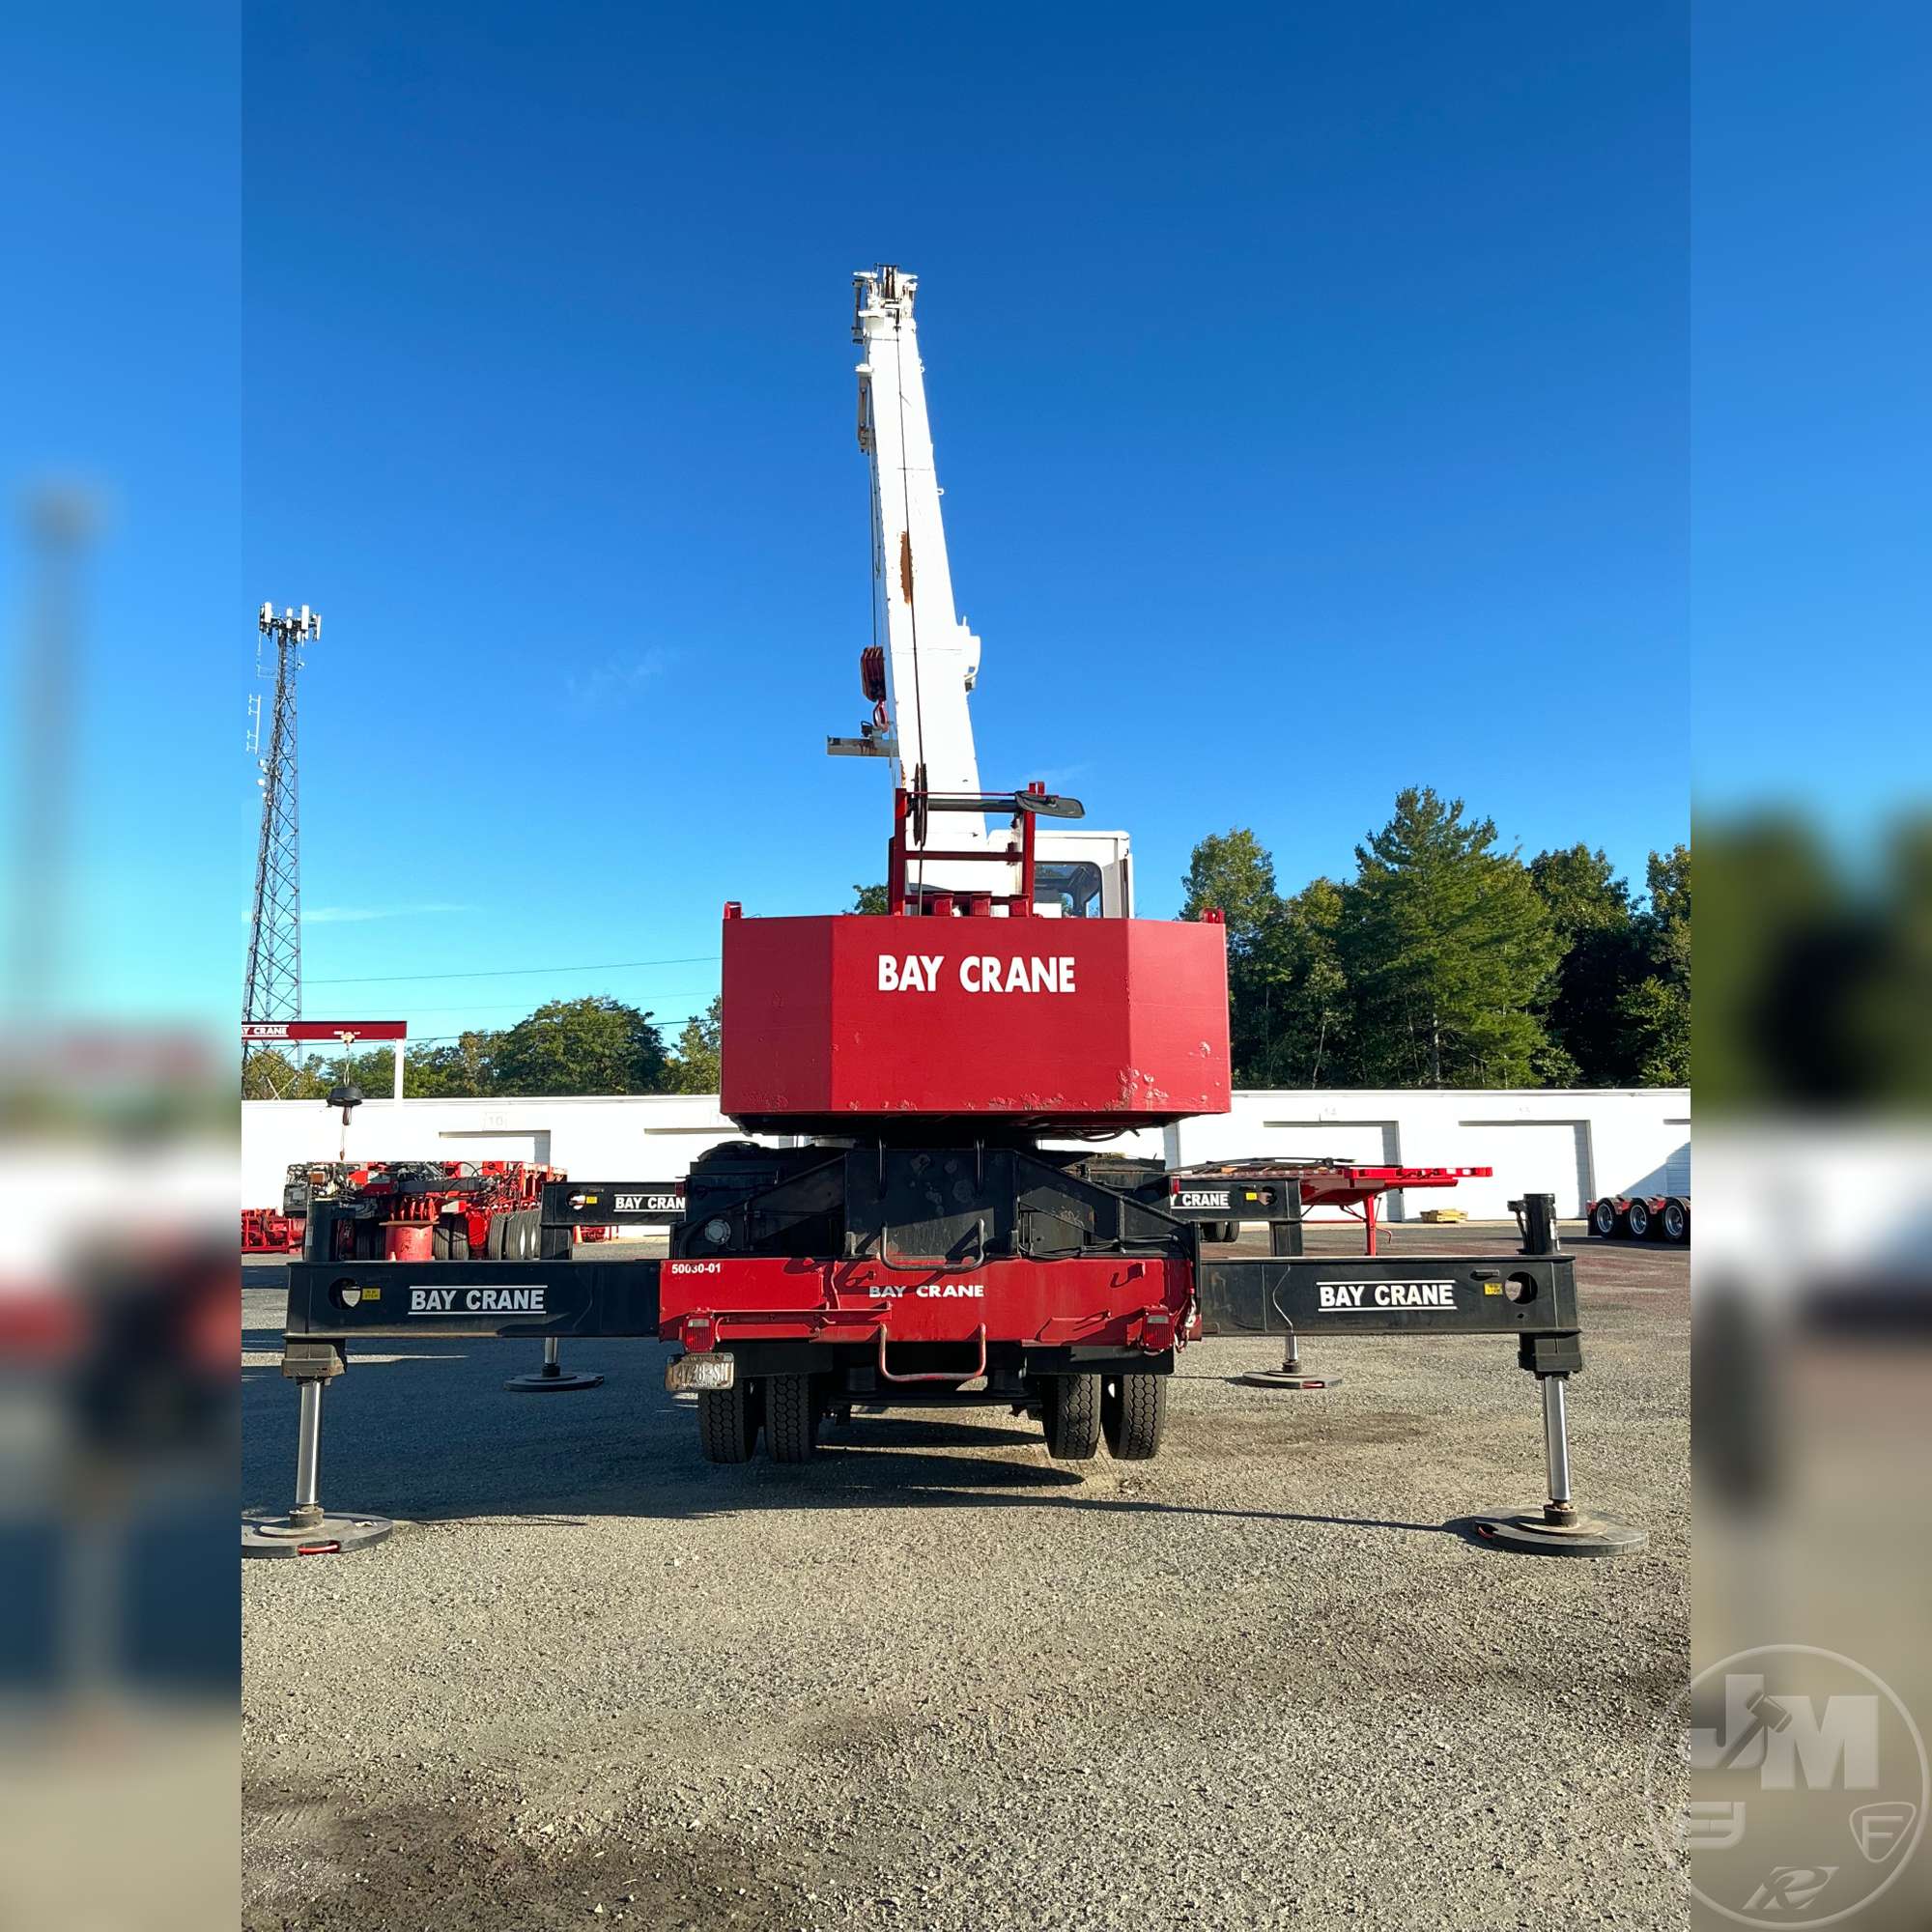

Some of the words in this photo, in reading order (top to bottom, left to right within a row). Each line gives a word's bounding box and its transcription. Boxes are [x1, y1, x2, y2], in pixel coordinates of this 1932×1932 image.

[878, 954, 945, 991] BAY
[959, 955, 1076, 993] CRANE
[615, 1197, 642, 1209] BAY
[647, 1197, 686, 1209] CRAN
[1181, 1193, 1229, 1207] CRANE
[671, 1263, 722, 1274] 50030-01
[868, 1285, 907, 1298] BAY
[916, 1285, 984, 1297] CRANE
[1320, 1285, 1365, 1307] BAY
[1374, 1284, 1455, 1306] CRANE
[411, 1290, 457, 1311] BAY
[466, 1290, 545, 1310] CRANE
